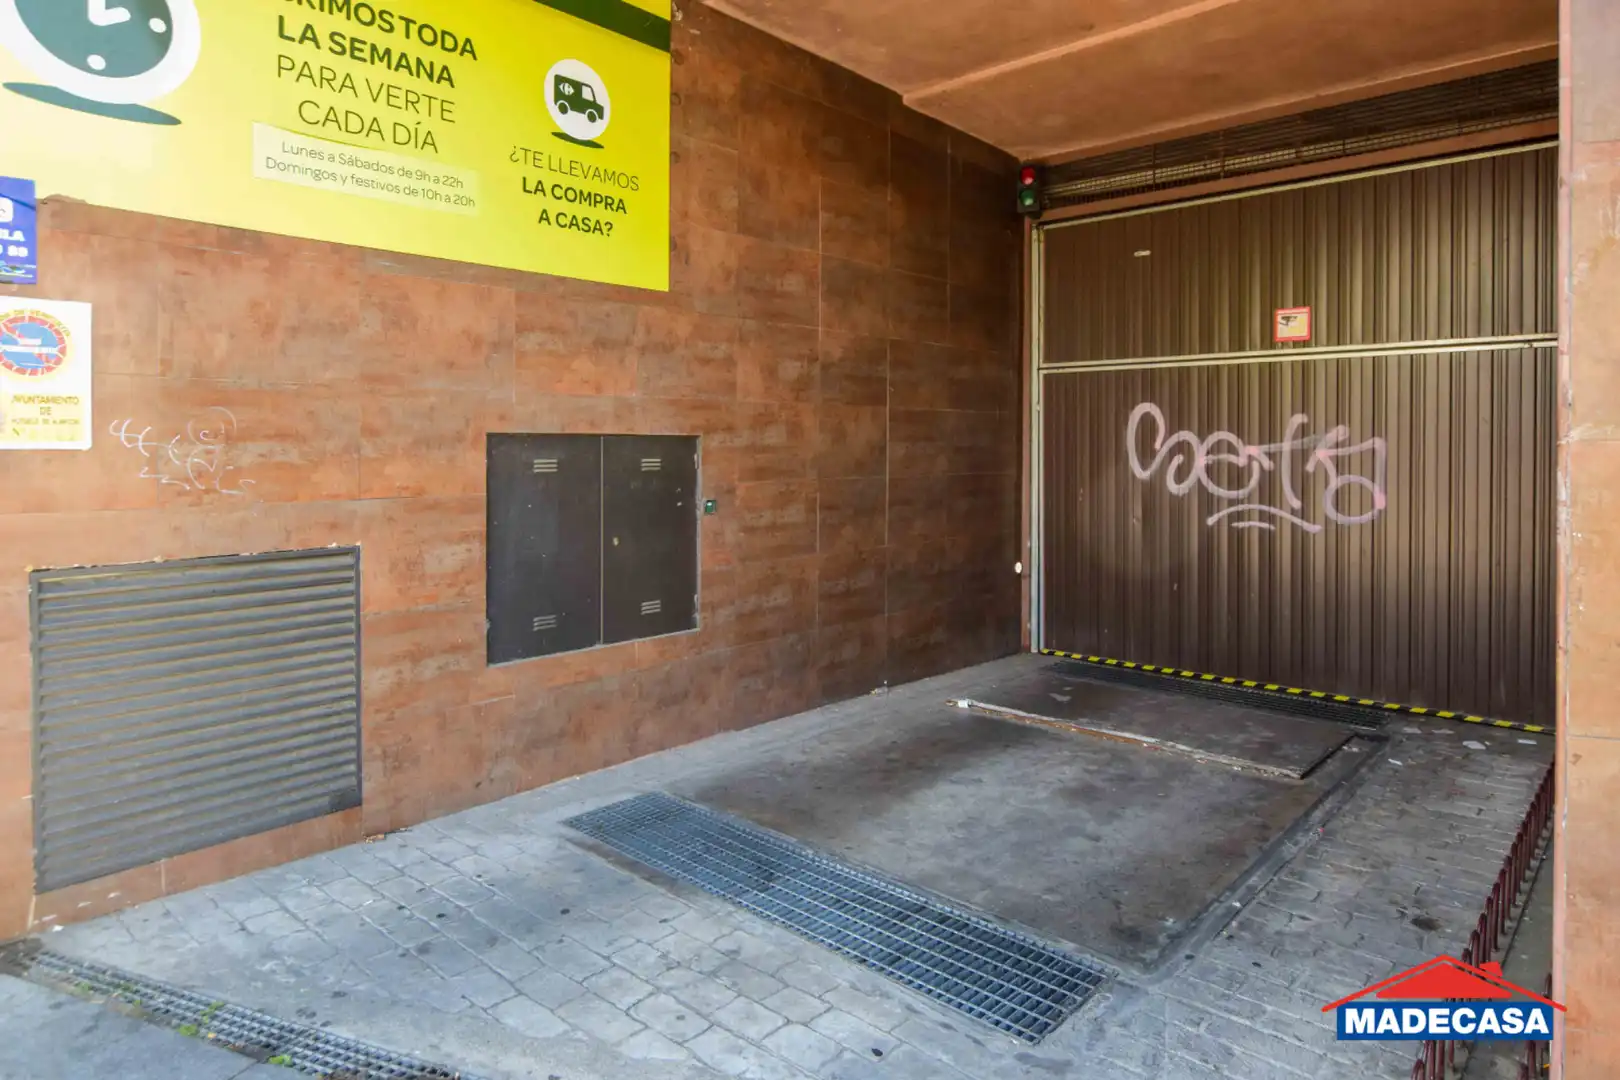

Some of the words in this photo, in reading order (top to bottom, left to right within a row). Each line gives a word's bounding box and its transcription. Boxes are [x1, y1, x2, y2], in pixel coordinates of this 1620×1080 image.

[278, 14, 321, 50] LA
[328, 31, 455, 89] SEMANA
[398, 15, 478, 61] TODA
[277, 54, 359, 98] PARA
[365, 78, 456, 123] VERTE
[298, 99, 385, 142] CADA
[393, 121, 438, 154] DÍA
[265, 156, 338, 182] Domingos
[340, 174, 348, 186] y
[350, 174, 401, 194] festivos
[403, 186, 419, 198] de
[421, 188, 442, 202] 10h
[444, 193, 452, 204] a
[453, 194, 476, 207] 20h
[282, 141, 325, 161] Lunes
[327, 153, 336, 163] a
[338, 150, 395, 176] Sábados
[397, 166, 413, 178] de
[415, 169, 431, 183] 9h
[432, 175, 441, 185] a
[442, 174, 464, 188] 22h
[509, 145, 544, 169] ¿TE
[548, 153, 640, 192] LLEVAMOS
[522, 176, 547, 198] LA
[551, 183, 628, 215] COMPRA
[538, 208, 552, 226] A
[555, 212, 614, 237] CASA?
